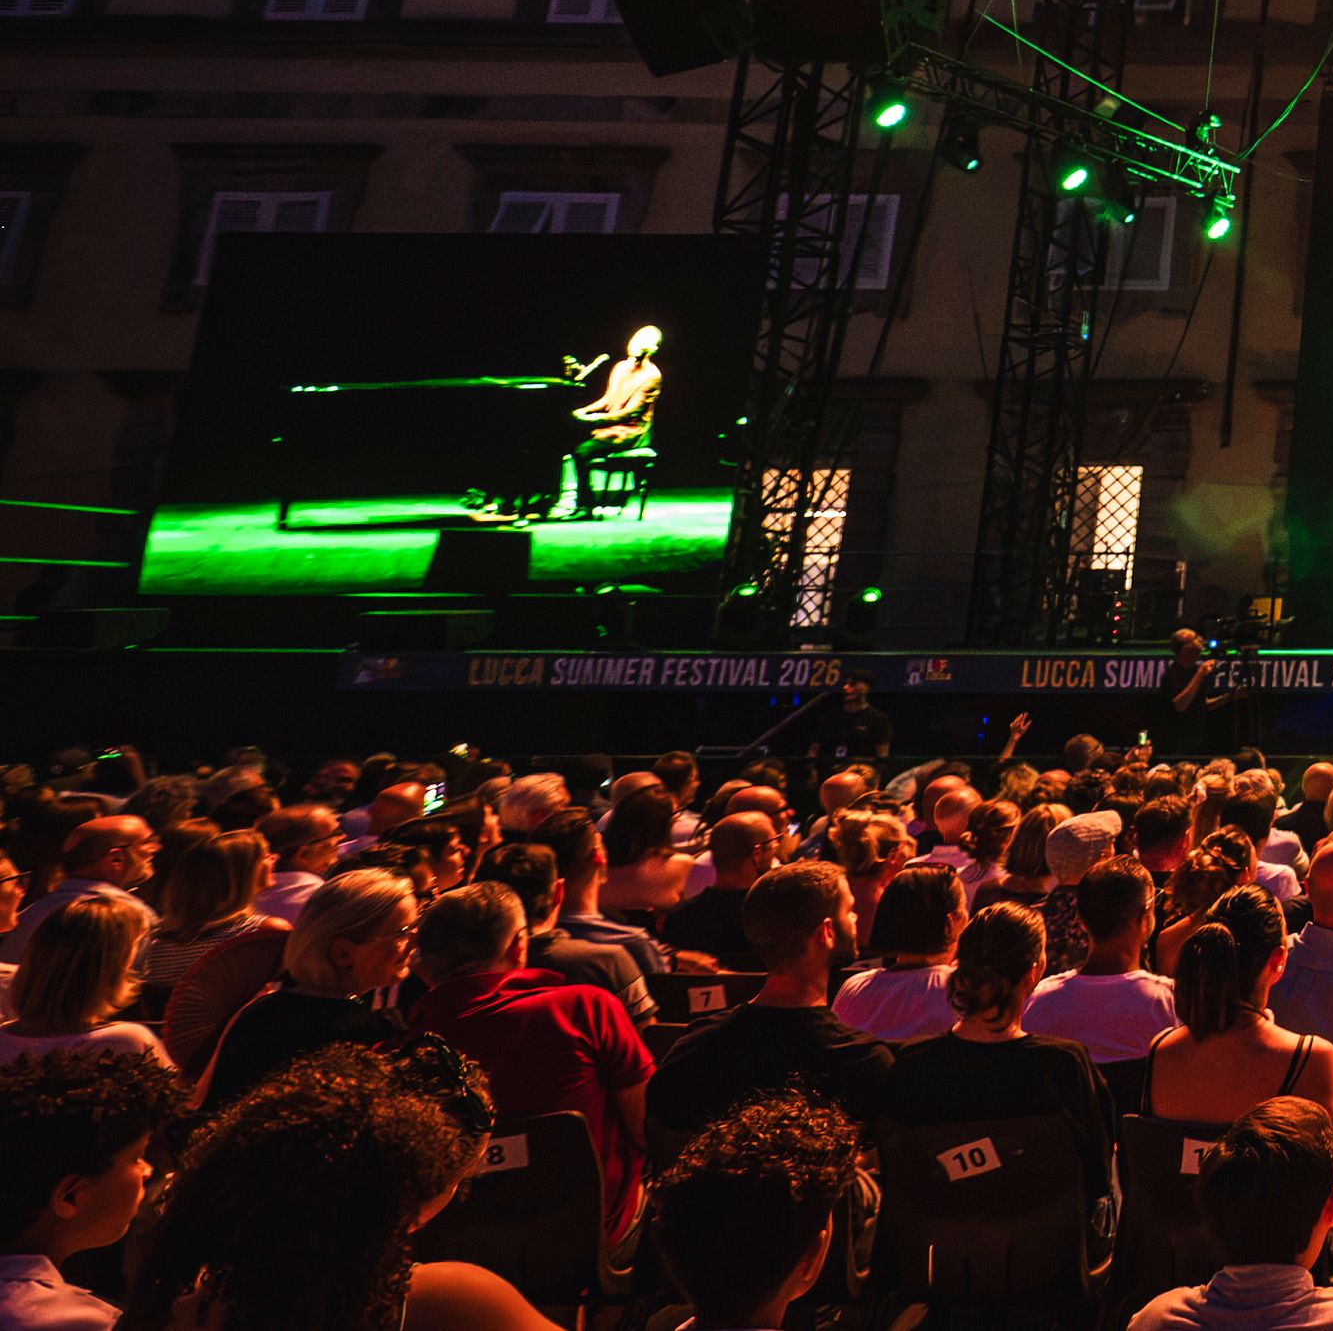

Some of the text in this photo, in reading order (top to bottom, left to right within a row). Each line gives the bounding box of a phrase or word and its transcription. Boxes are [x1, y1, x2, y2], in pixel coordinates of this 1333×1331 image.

[468, 657, 843, 688] LUCCA SUMMER FESTIVAL 2026
[1019, 659, 1097, 688] LUCCA
[699, 990, 711, 1008] 7
[486, 1144, 505, 1166] 8
[952, 1146, 986, 1173] 10
